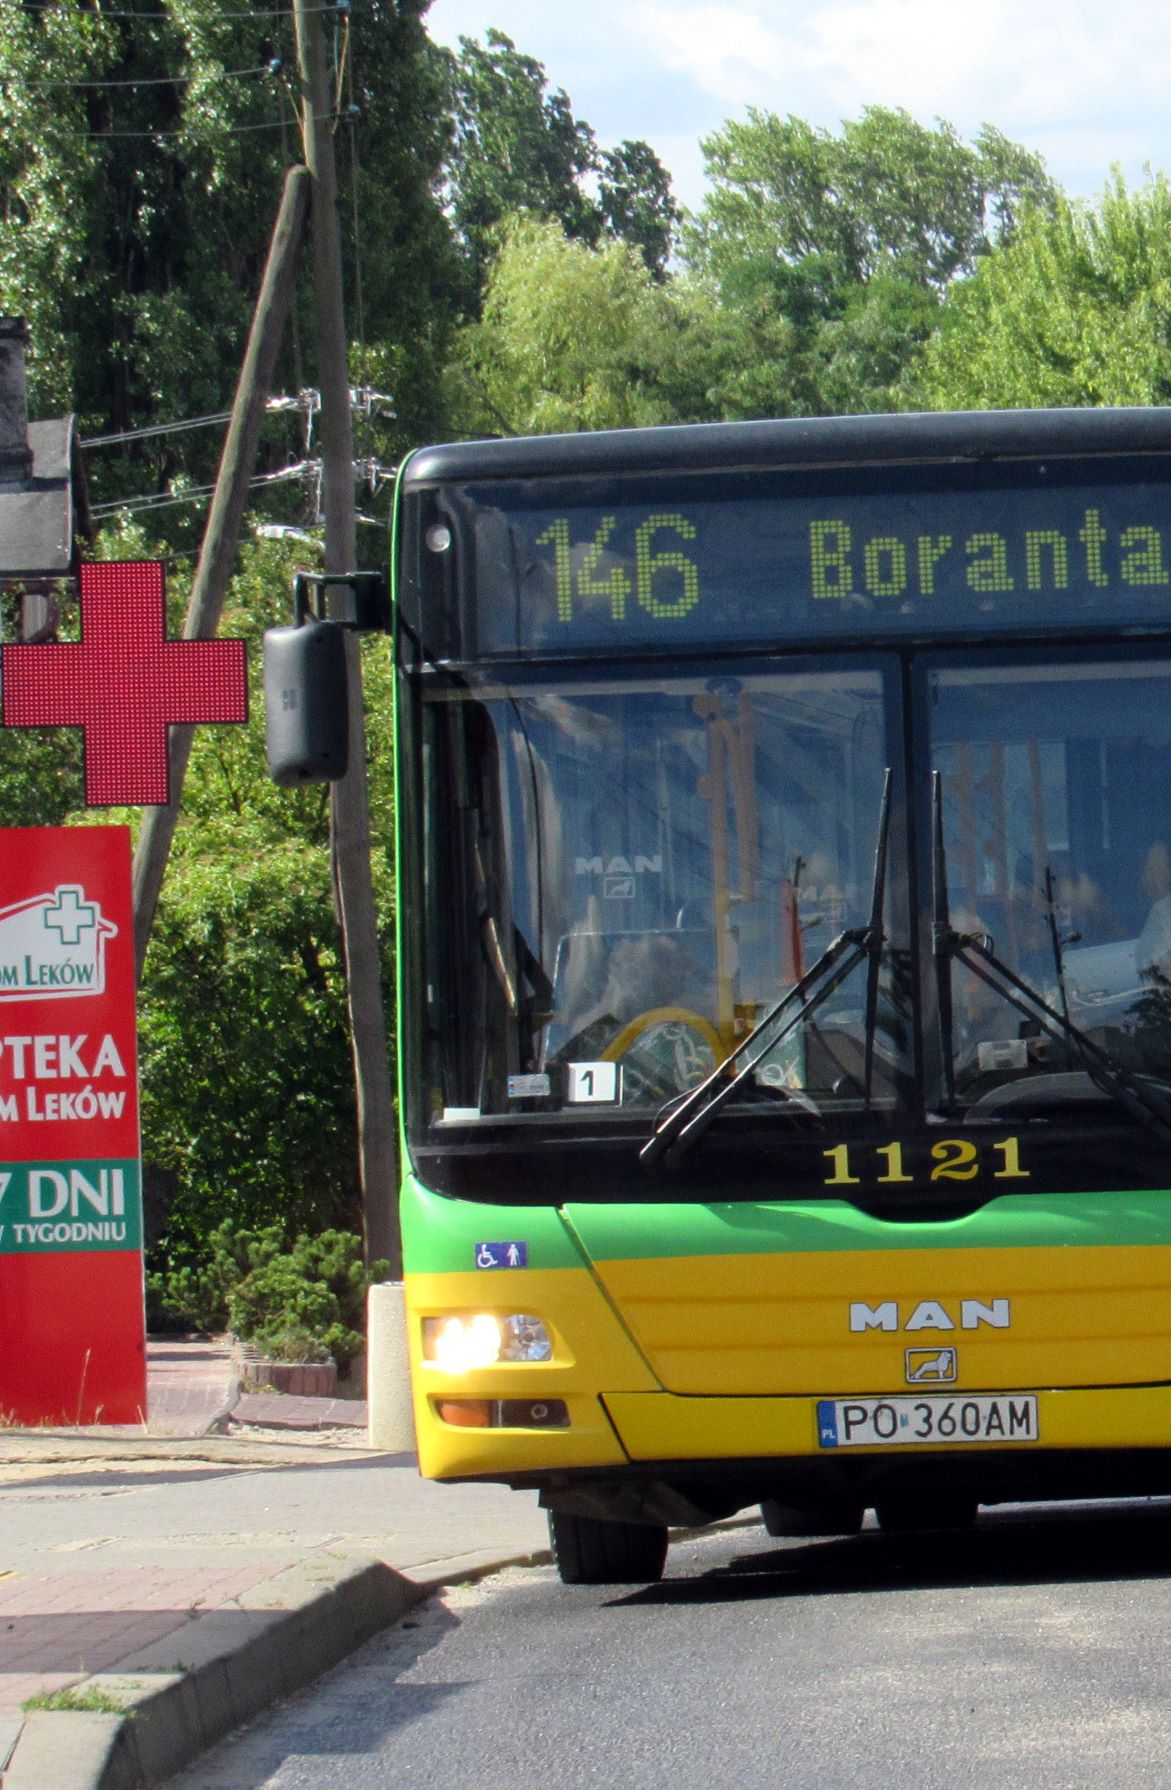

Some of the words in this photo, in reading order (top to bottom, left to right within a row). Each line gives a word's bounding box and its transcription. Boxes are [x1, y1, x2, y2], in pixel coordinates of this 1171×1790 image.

[536, 513, 698, 622] 146
[809, 508, 1169, 600] Boranta
[575, 855, 662, 874] MAN
[580, 1070, 595, 1096] 1
[823, 1137, 1031, 1184] 1121
[29, 1169, 125, 1218] DNI
[14, 1221, 126, 1243] TYGODNIU
[850, 1299, 1011, 1332] MAN
[822, 1429, 836, 1439] PL
[842, 1404, 898, 1441] PO
[914, 1400, 1032, 1438] 360AM
